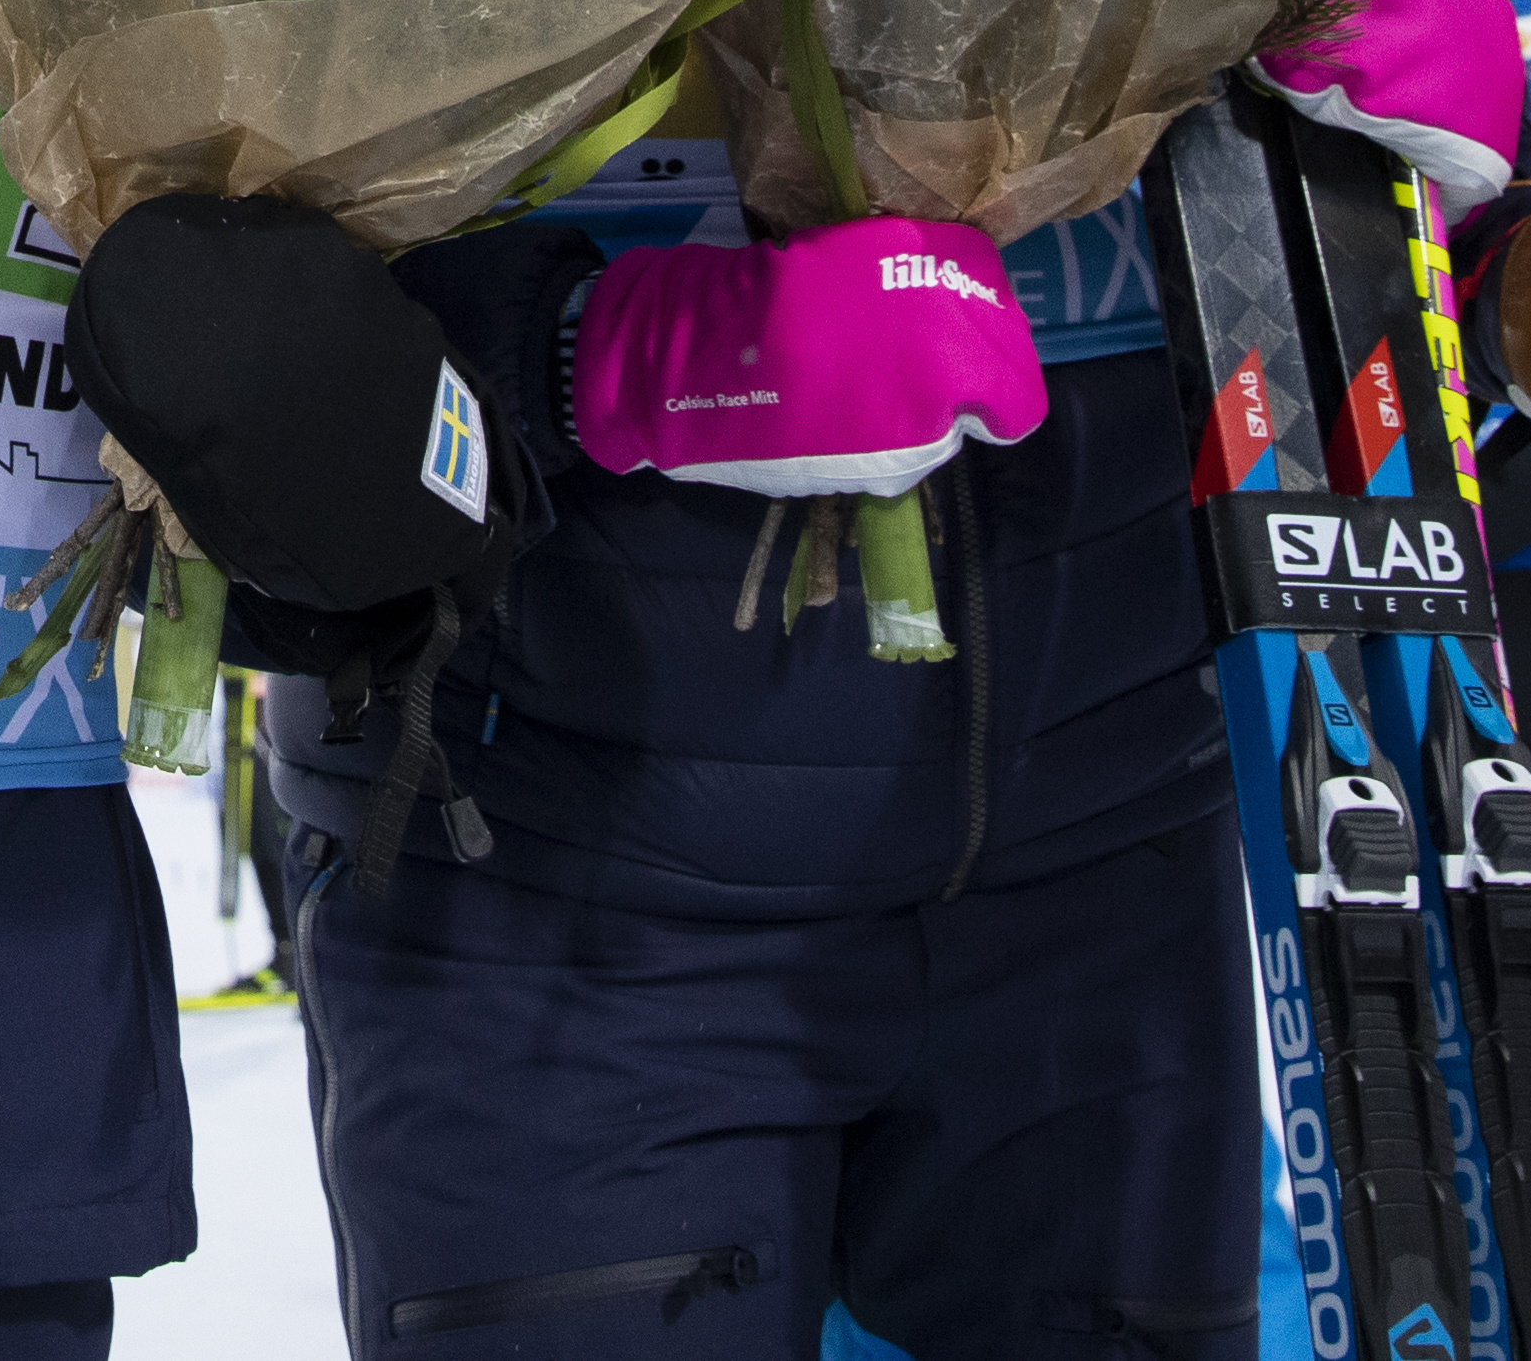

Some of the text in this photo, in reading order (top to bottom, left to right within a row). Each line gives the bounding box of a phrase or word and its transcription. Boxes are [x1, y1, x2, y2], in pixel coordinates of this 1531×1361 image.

[1409, 236, 1482, 506] LEKI
[666, 390, 780, 413] Celsius Race Mitt
[1281, 592, 1469, 615] SELECT
